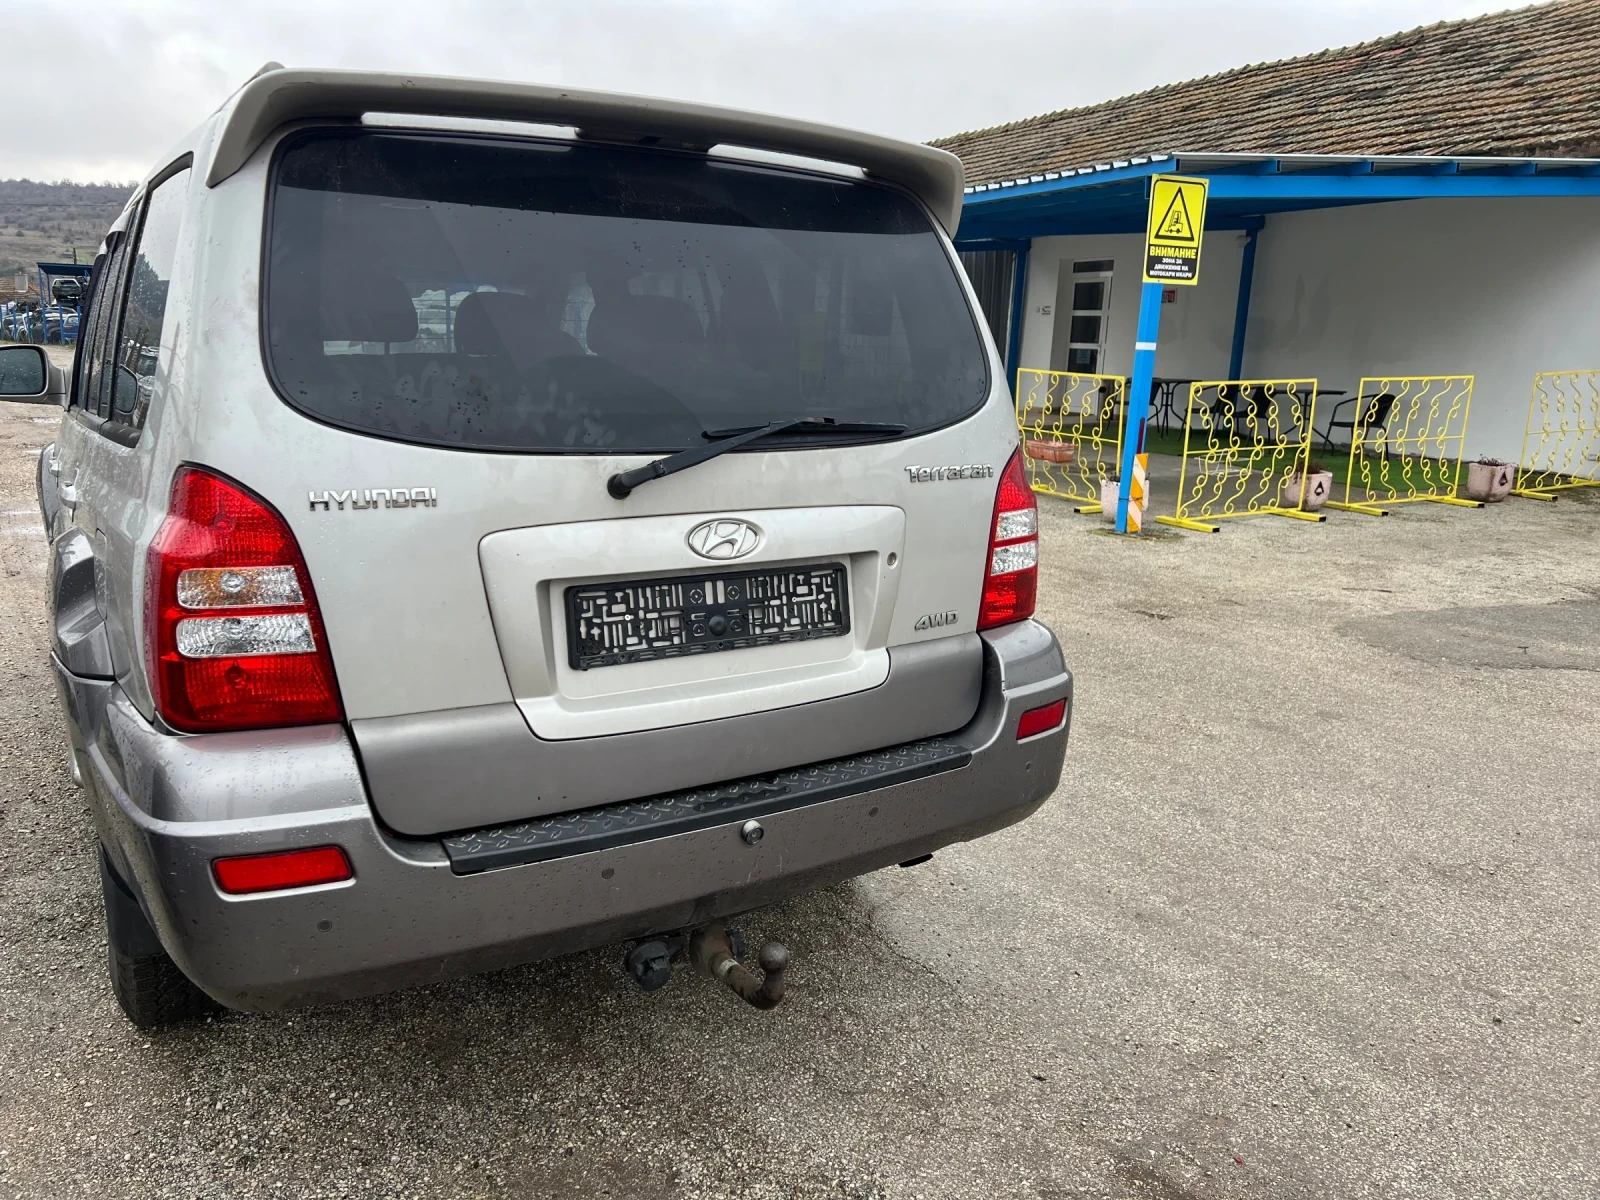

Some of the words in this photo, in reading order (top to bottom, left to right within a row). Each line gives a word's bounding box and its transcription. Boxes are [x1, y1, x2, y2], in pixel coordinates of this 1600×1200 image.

[1149, 246, 1197, 259] ВНИМАНИЕ
[904, 463, 994, 483] Terracan
[308, 487, 438, 511] HYUNDAI
[914, 609, 959, 631] 4WD
